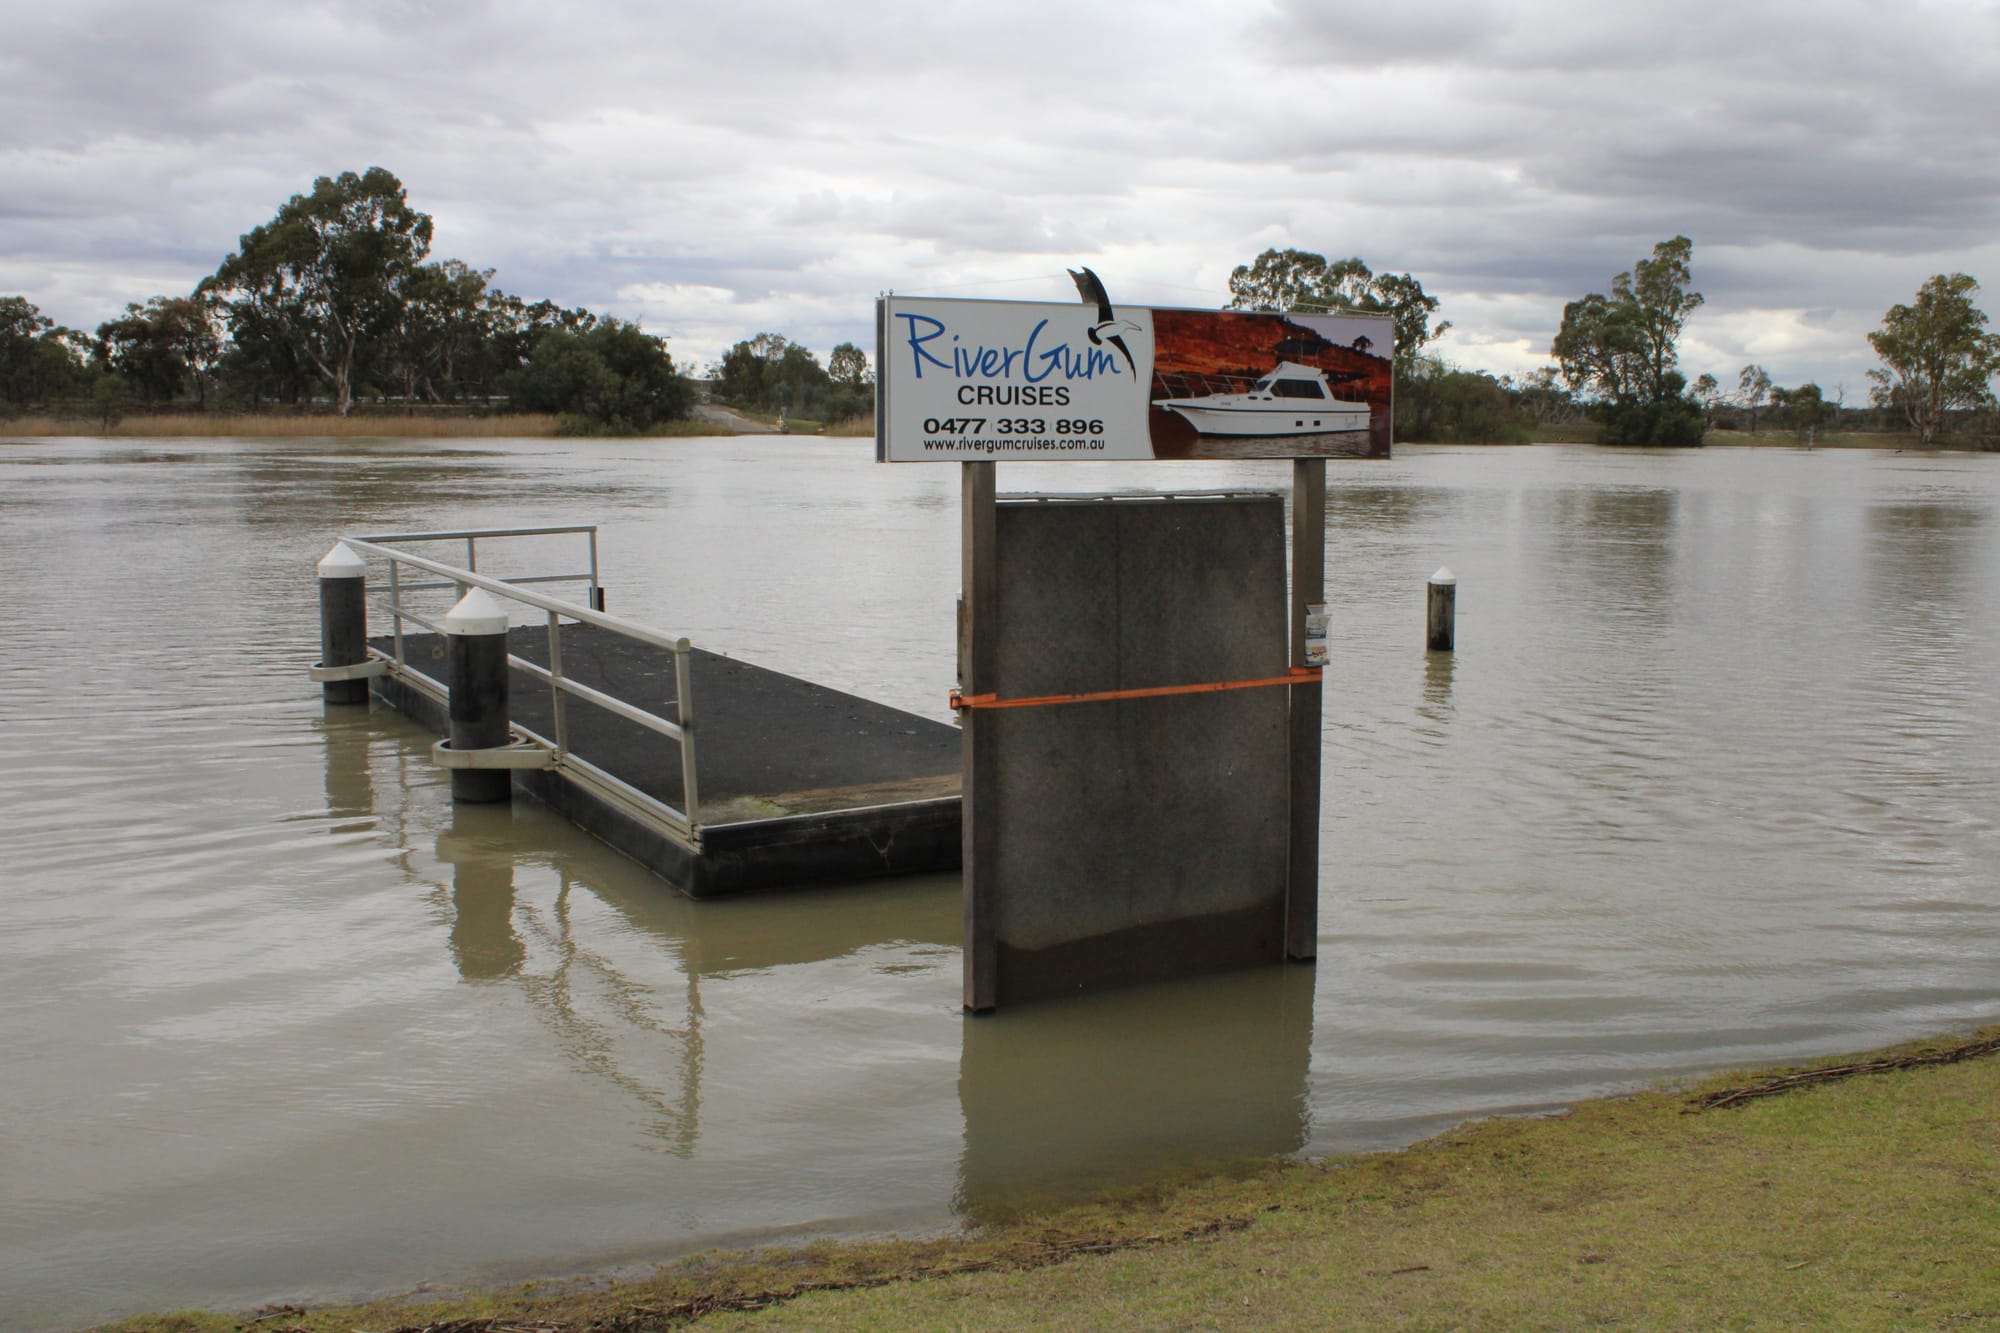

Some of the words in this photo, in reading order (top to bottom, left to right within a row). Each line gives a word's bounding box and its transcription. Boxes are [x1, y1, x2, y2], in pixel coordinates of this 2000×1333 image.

[895, 313, 1121, 383] RiverGum
[957, 385, 1070, 406] CRUISES
[923, 418, 987, 435] 0477
[997, 418, 1046, 435] 333
[1055, 418, 1104, 435] 896
[923, 436, 1105, 453] www.rivergumcruises.com.au
